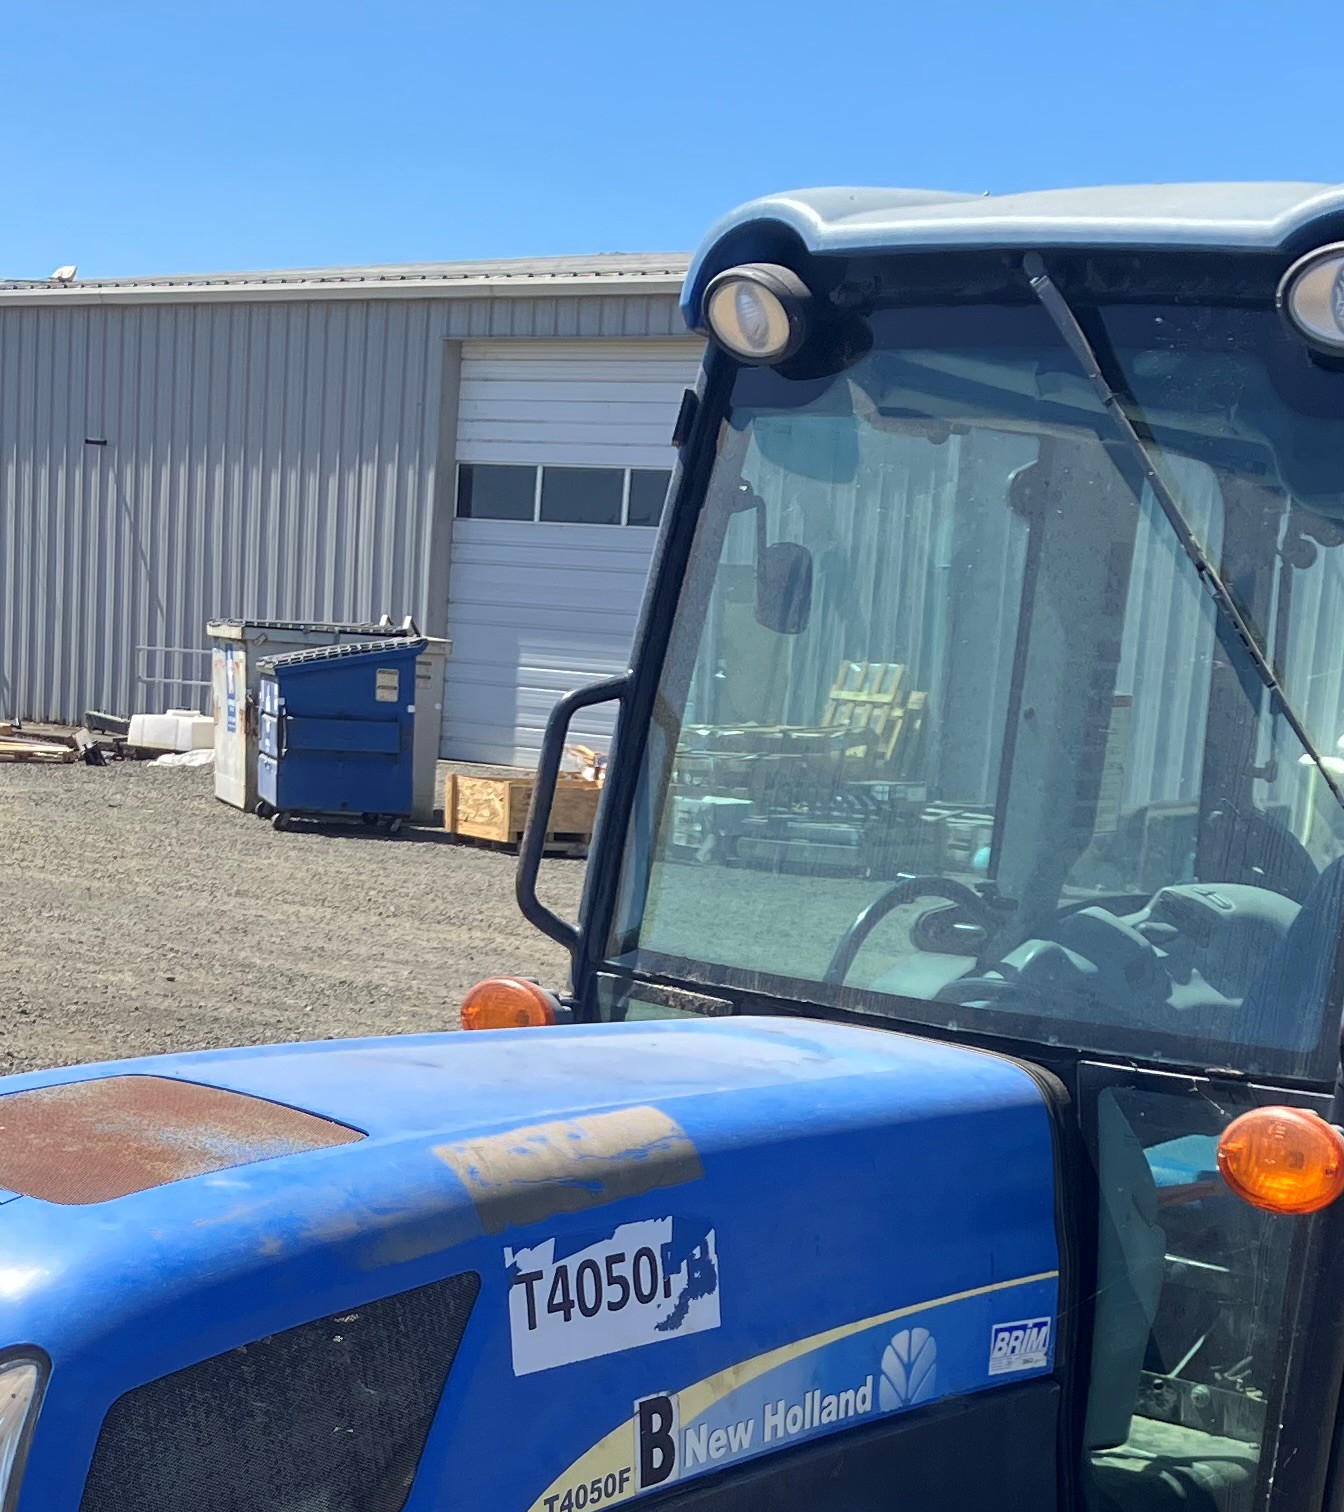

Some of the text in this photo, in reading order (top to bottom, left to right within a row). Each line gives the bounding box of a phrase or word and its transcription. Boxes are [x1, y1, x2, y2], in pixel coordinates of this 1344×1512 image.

[639, 1395, 676, 1489] B
[684, 1375, 873, 1467] New Holland
